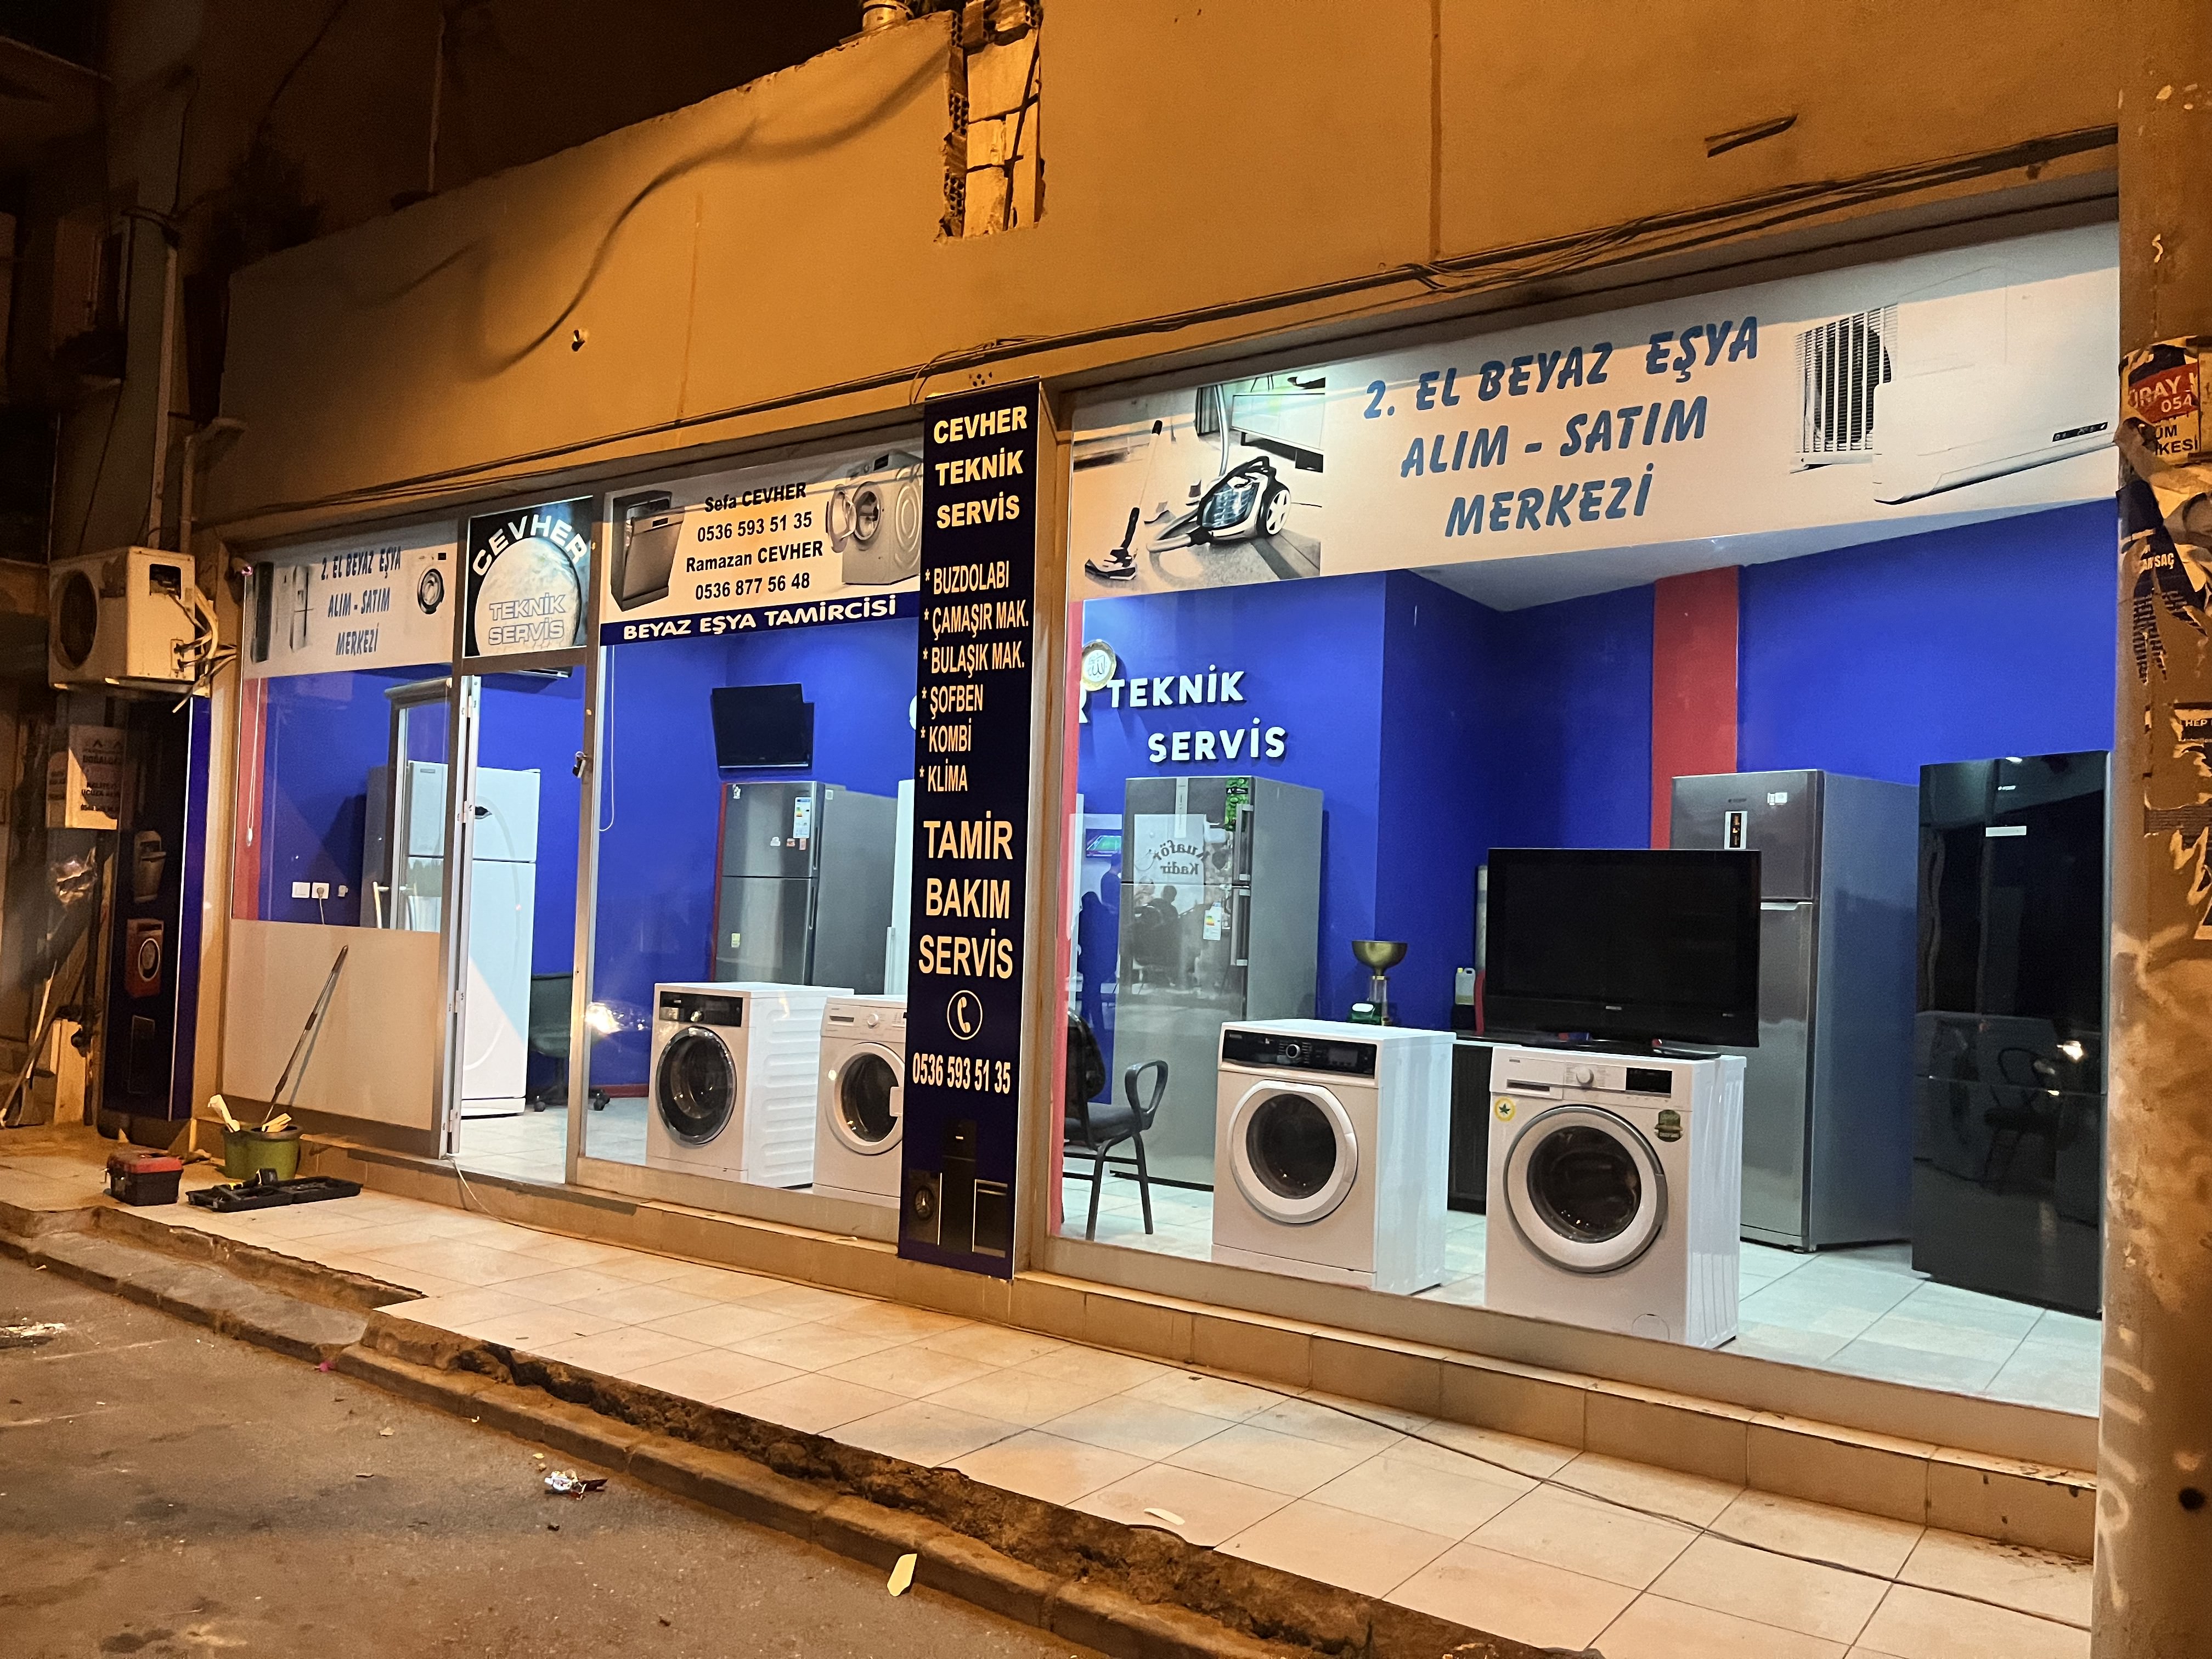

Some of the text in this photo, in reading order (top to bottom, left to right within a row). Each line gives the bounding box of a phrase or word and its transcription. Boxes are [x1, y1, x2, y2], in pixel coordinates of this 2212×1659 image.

[1363, 316, 1758, 419] 2. EL BEYAZ EŞYA
[934, 406, 1027, 444] CEVHER
[1400, 425, 1509, 478] ALIM
[1560, 396, 1707, 457] SATIM
[935, 447, 1024, 486] TEKNİK
[704, 482, 806, 512] Sefa CEVHER
[936, 491, 1020, 529] SERVİS
[1445, 462, 1654, 537] MERKEZİ
[472, 514, 587, 576] CEVHER
[697, 511, 812, 542] 0536 593 51 35
[332, 555, 342, 578] EL
[346, 550, 374, 577] BEYAZ
[379, 546, 401, 579] EŞYA
[686, 540, 823, 573] Ramazan CEVHER
[696, 572, 810, 600] 0536 877 56 48
[934, 561, 1009, 595] BUZDOLABI
[328, 592, 351, 618] ALIM
[361, 586, 391, 614] SATIM
[489, 592, 566, 622] TEKNİK
[623, 595, 896, 640] BEYAZ EŞYA TAMİRCİSİ
[932, 599, 1029, 641] ÇAMAŞIR MAK.
[336, 622, 379, 656] MERKEZİ
[488, 619, 564, 646] SERVİS
[931, 641, 1025, 679] BULAŞIK MAK.
[930, 684, 983, 720] ŞOFBEN
[1107, 664, 1244, 708] TEKNİK
[929, 718, 972, 753] KOMBİ
[1148, 718, 1286, 763] SERVİS
[928, 758, 968, 792] KLİMA
[923, 810, 1013, 860] TAMİR
[926, 878, 1010, 918] BAKIM
[918, 928, 1013, 979] SERVİS
[912, 1052, 1011, 1094] 0536 593 51 35
